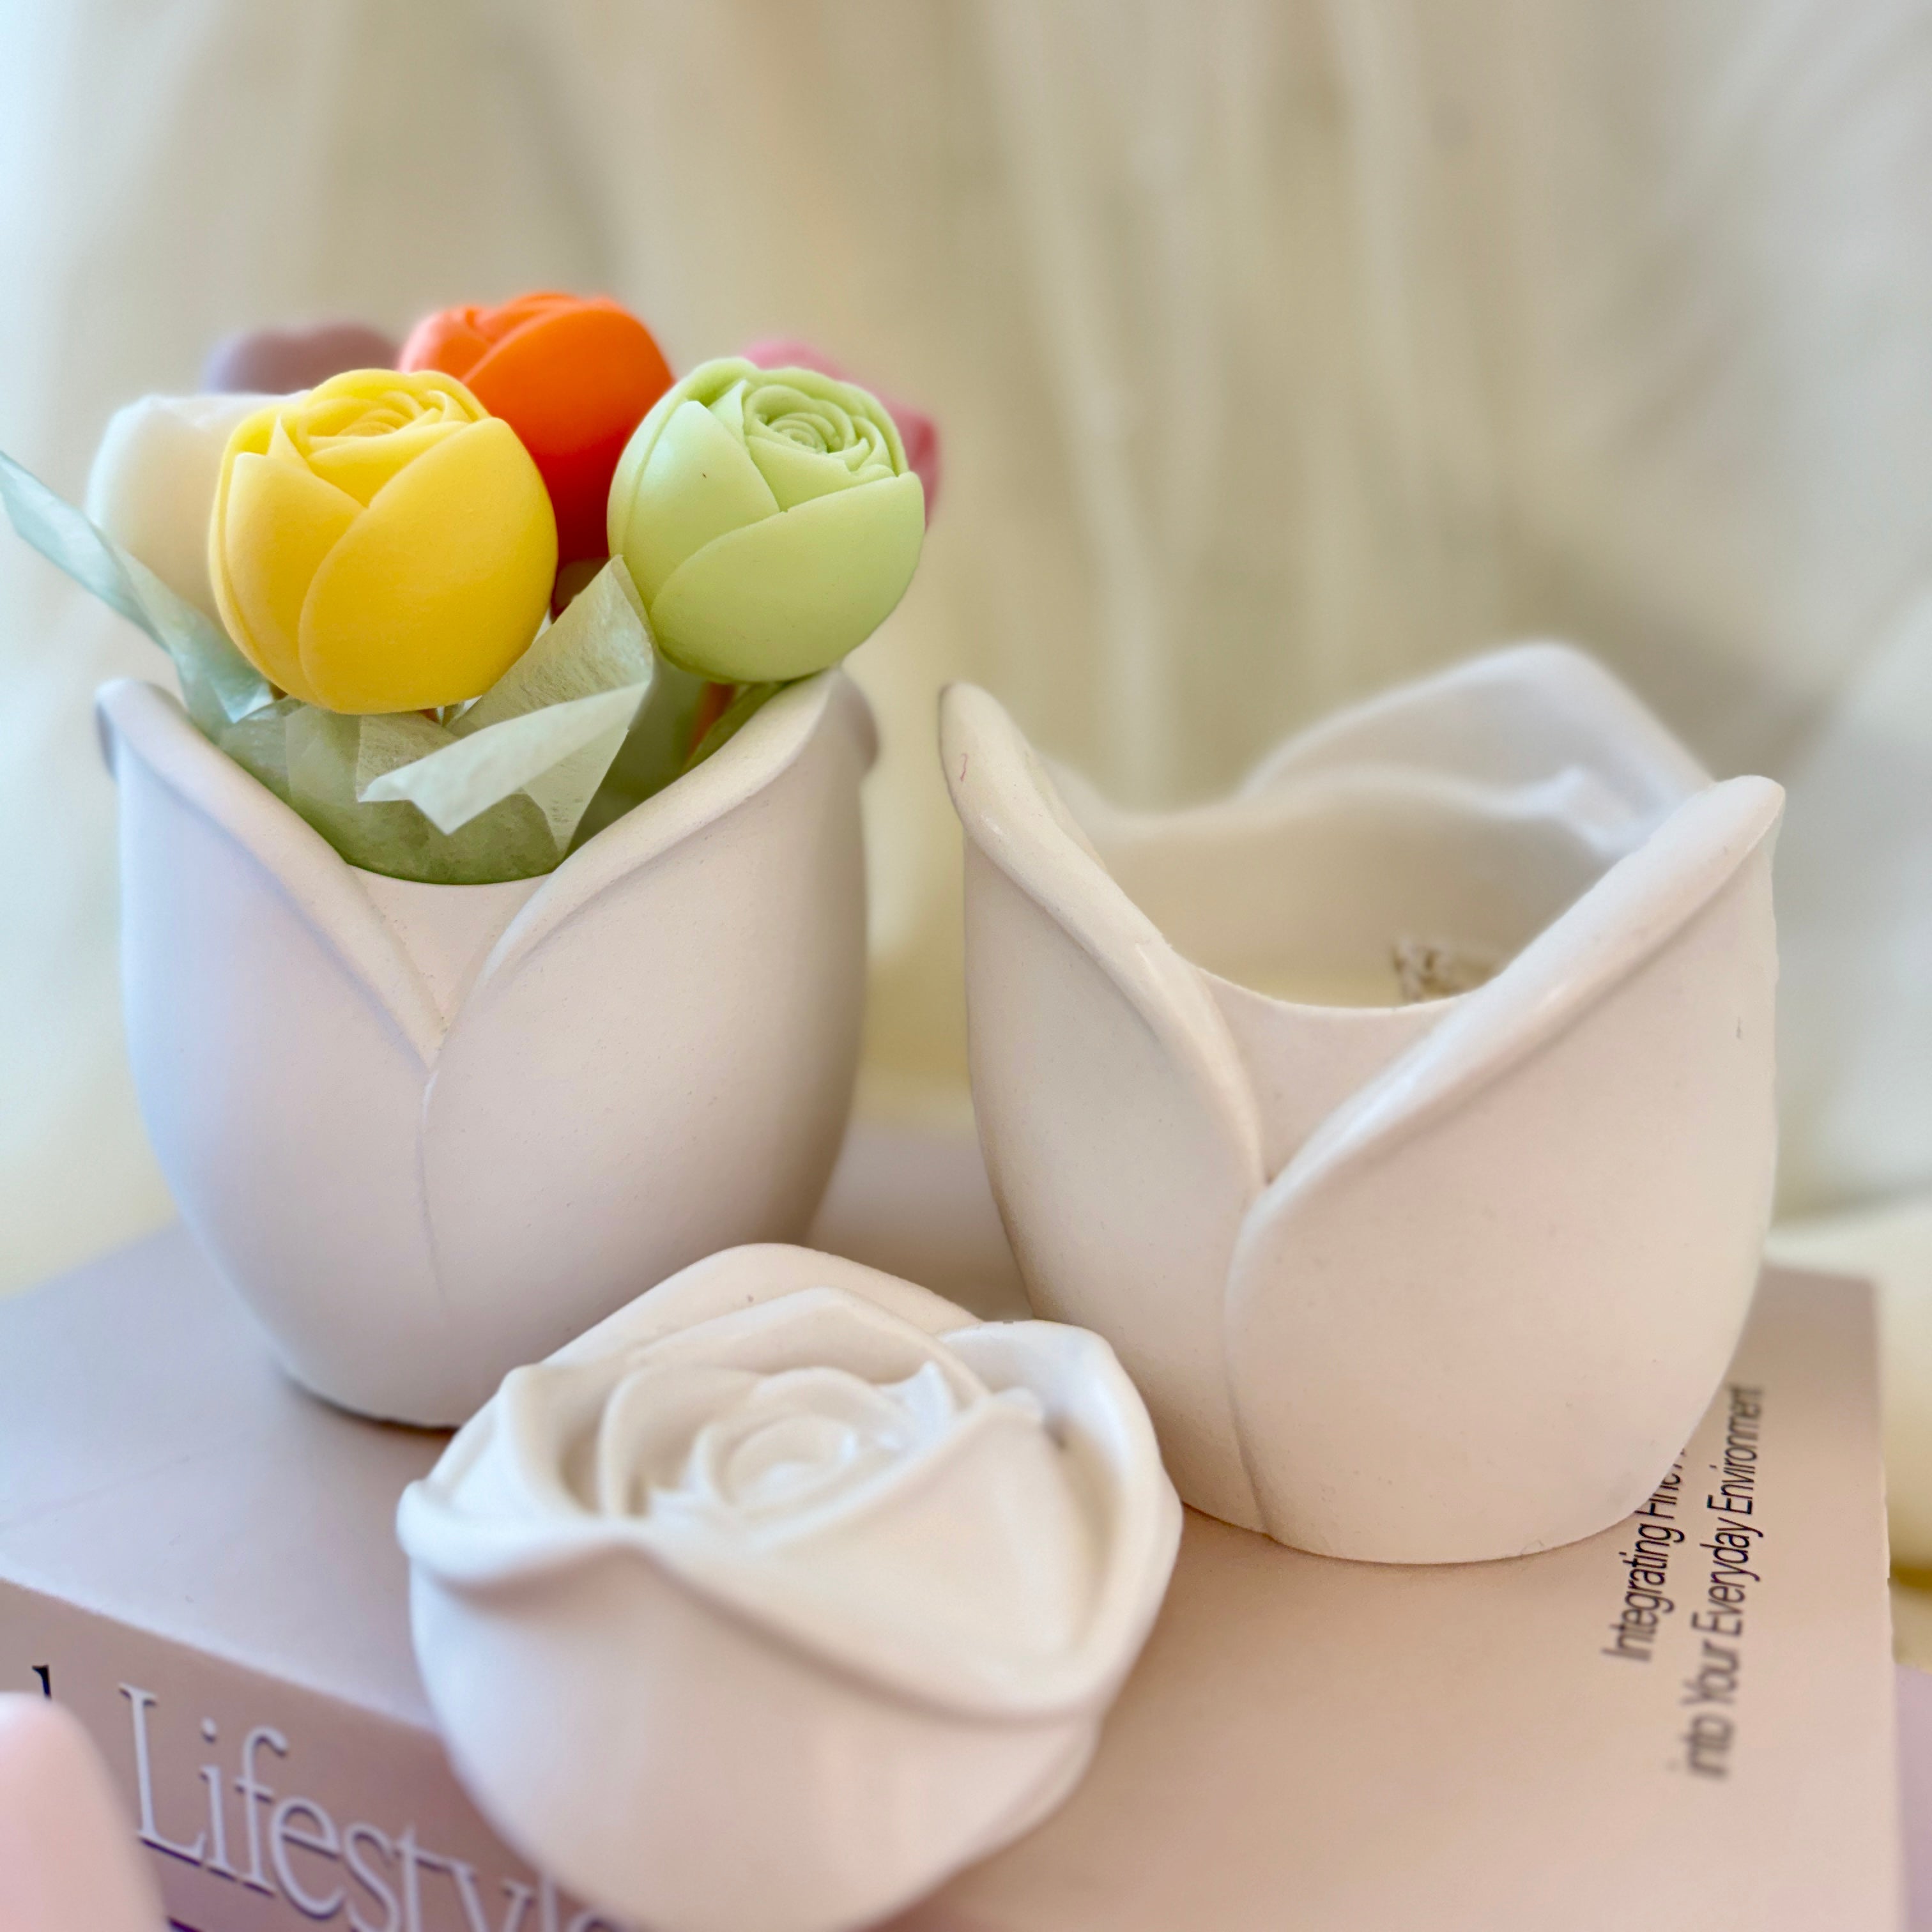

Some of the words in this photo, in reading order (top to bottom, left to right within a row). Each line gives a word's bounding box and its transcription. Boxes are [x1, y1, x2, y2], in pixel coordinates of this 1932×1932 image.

[1706, 1384, 1763, 1515] Environment
[1602, 1523, 1685, 1662] Integrating
[1692, 1517, 1763, 1637] Everyday
[1680, 1639, 1740, 1706] Your
[1668, 1711, 1735, 1781] into
